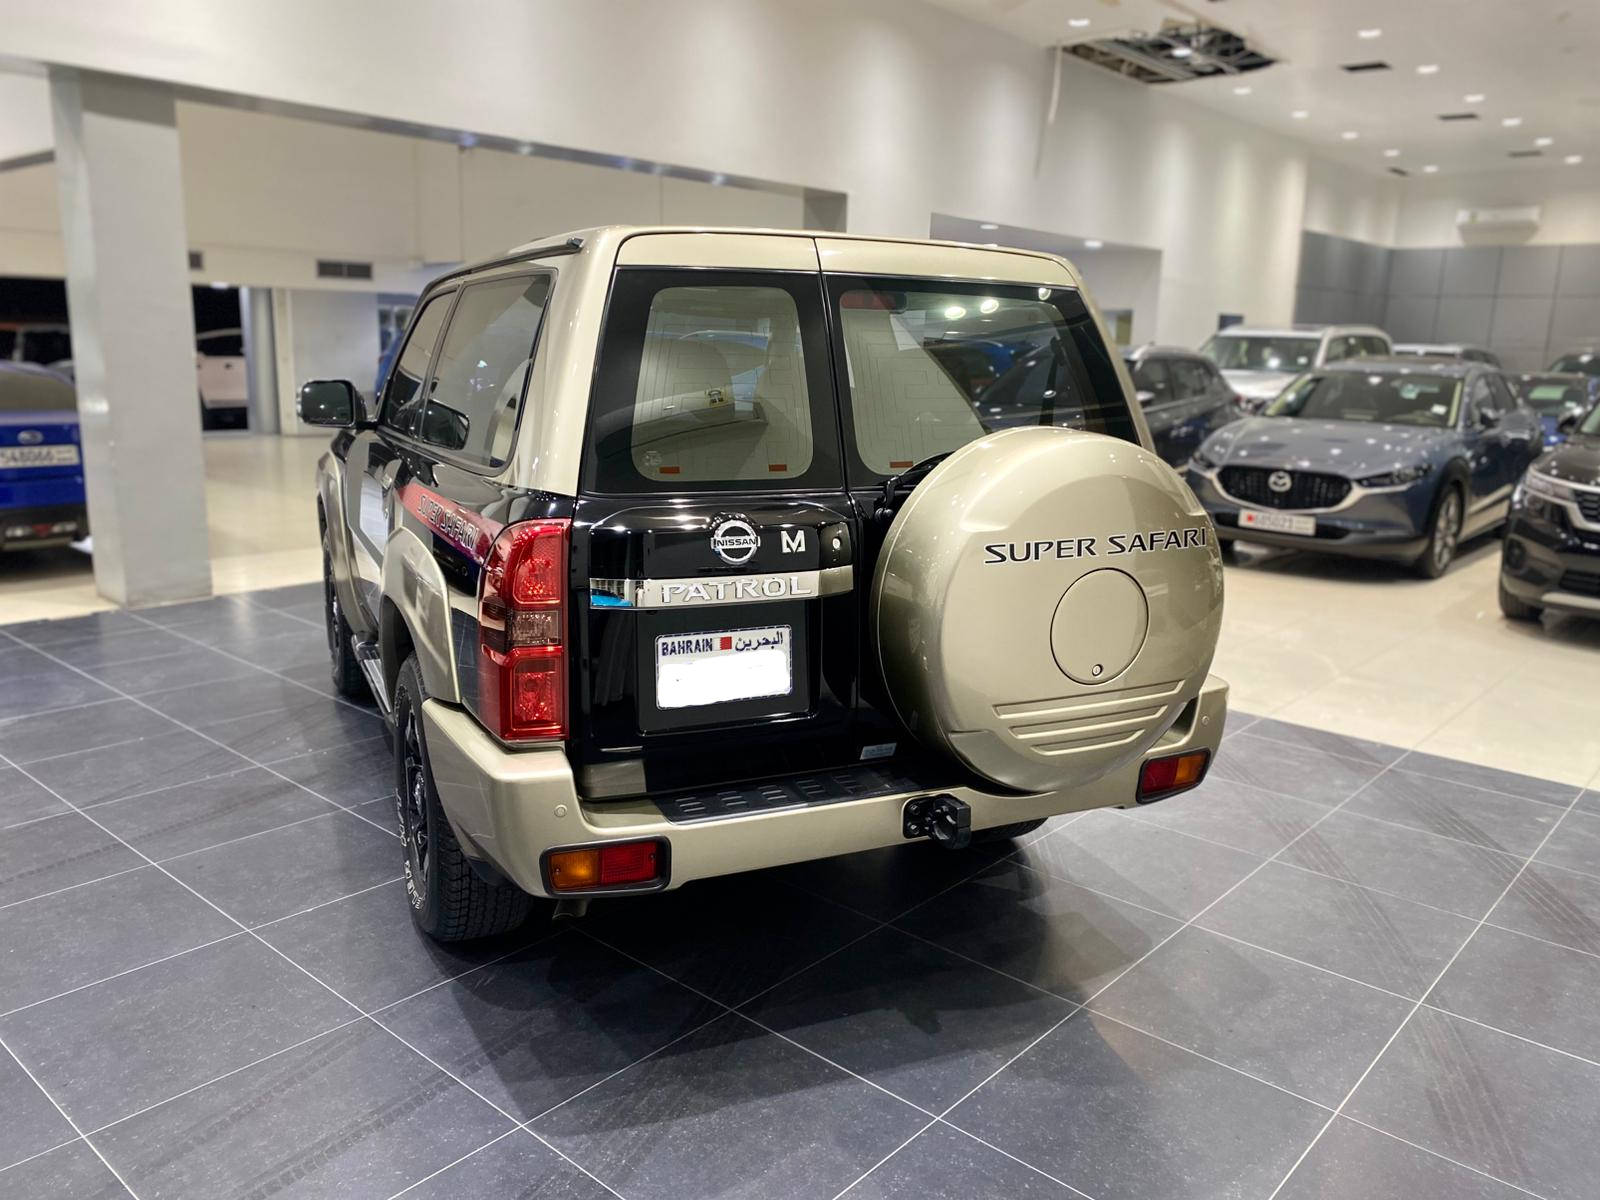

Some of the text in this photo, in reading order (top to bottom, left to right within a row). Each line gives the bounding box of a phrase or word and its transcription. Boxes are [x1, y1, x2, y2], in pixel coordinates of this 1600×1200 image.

[417, 494, 480, 551] SUPER SAFARI
[716, 538, 756, 547] NISSAN
[780, 529, 806, 553] M
[983, 527, 1208, 565] SUPER SAFARI
[662, 575, 812, 603] PATROL
[661, 638, 714, 657] BAHRAIN
[734, 630, 784, 652] البحرين
